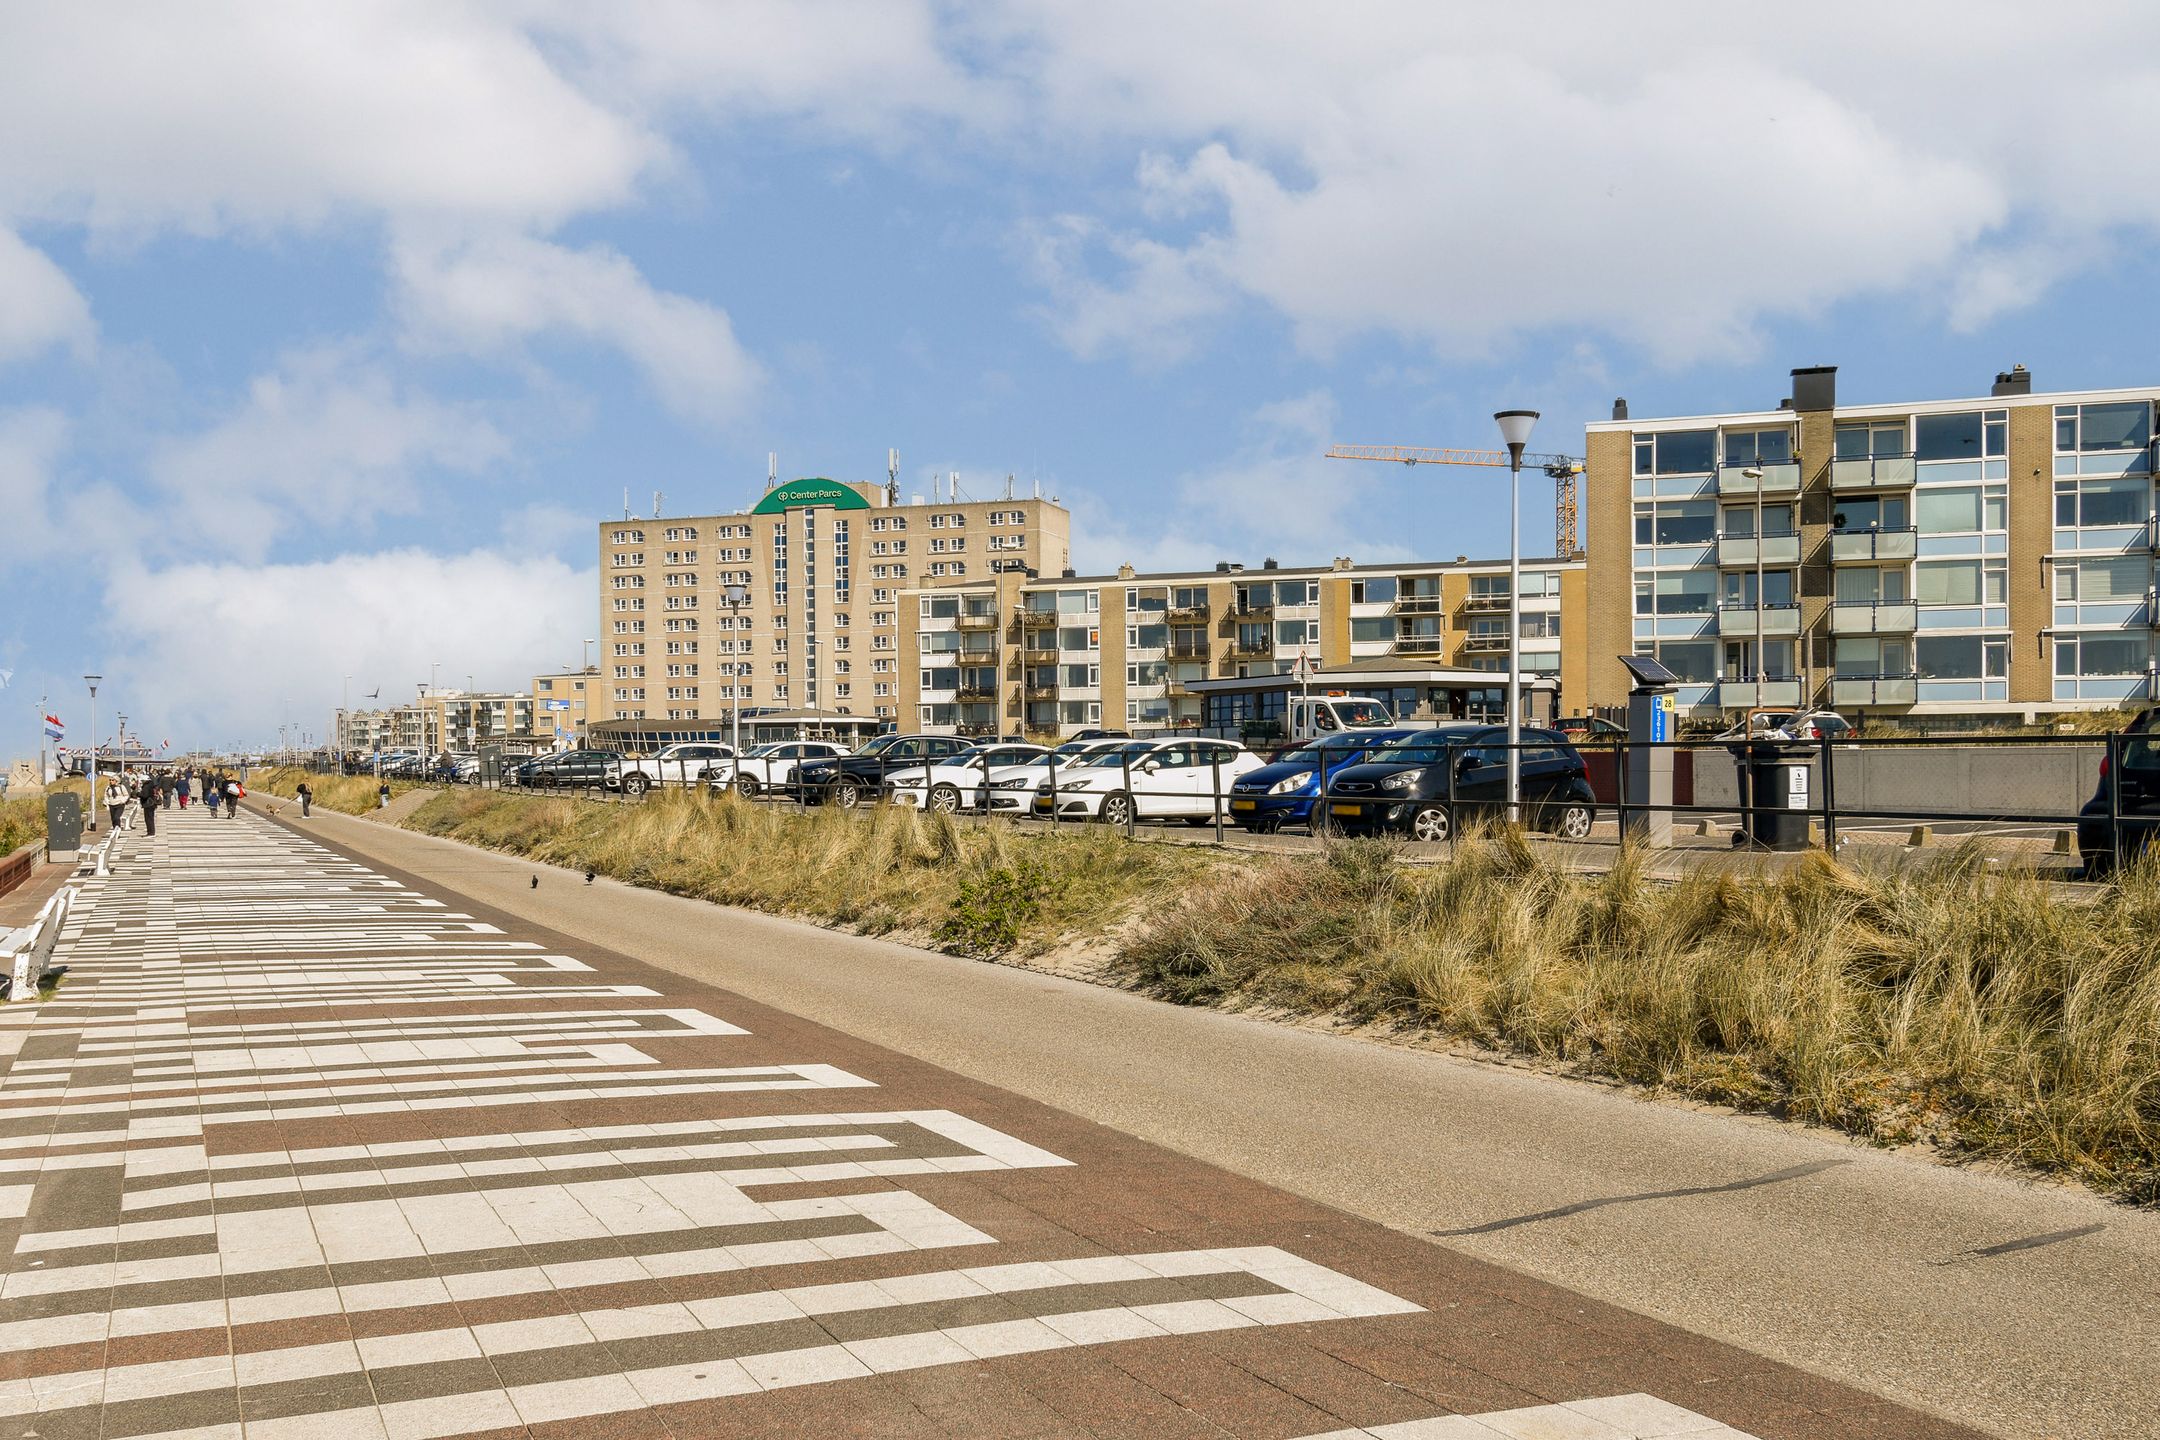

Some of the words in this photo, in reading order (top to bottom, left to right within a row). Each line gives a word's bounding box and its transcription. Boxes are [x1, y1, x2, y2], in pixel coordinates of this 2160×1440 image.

[790, 491, 817, 499] Center
[818, 489, 842, 498] Parcs
[1664, 699, 1672, 708] 28
